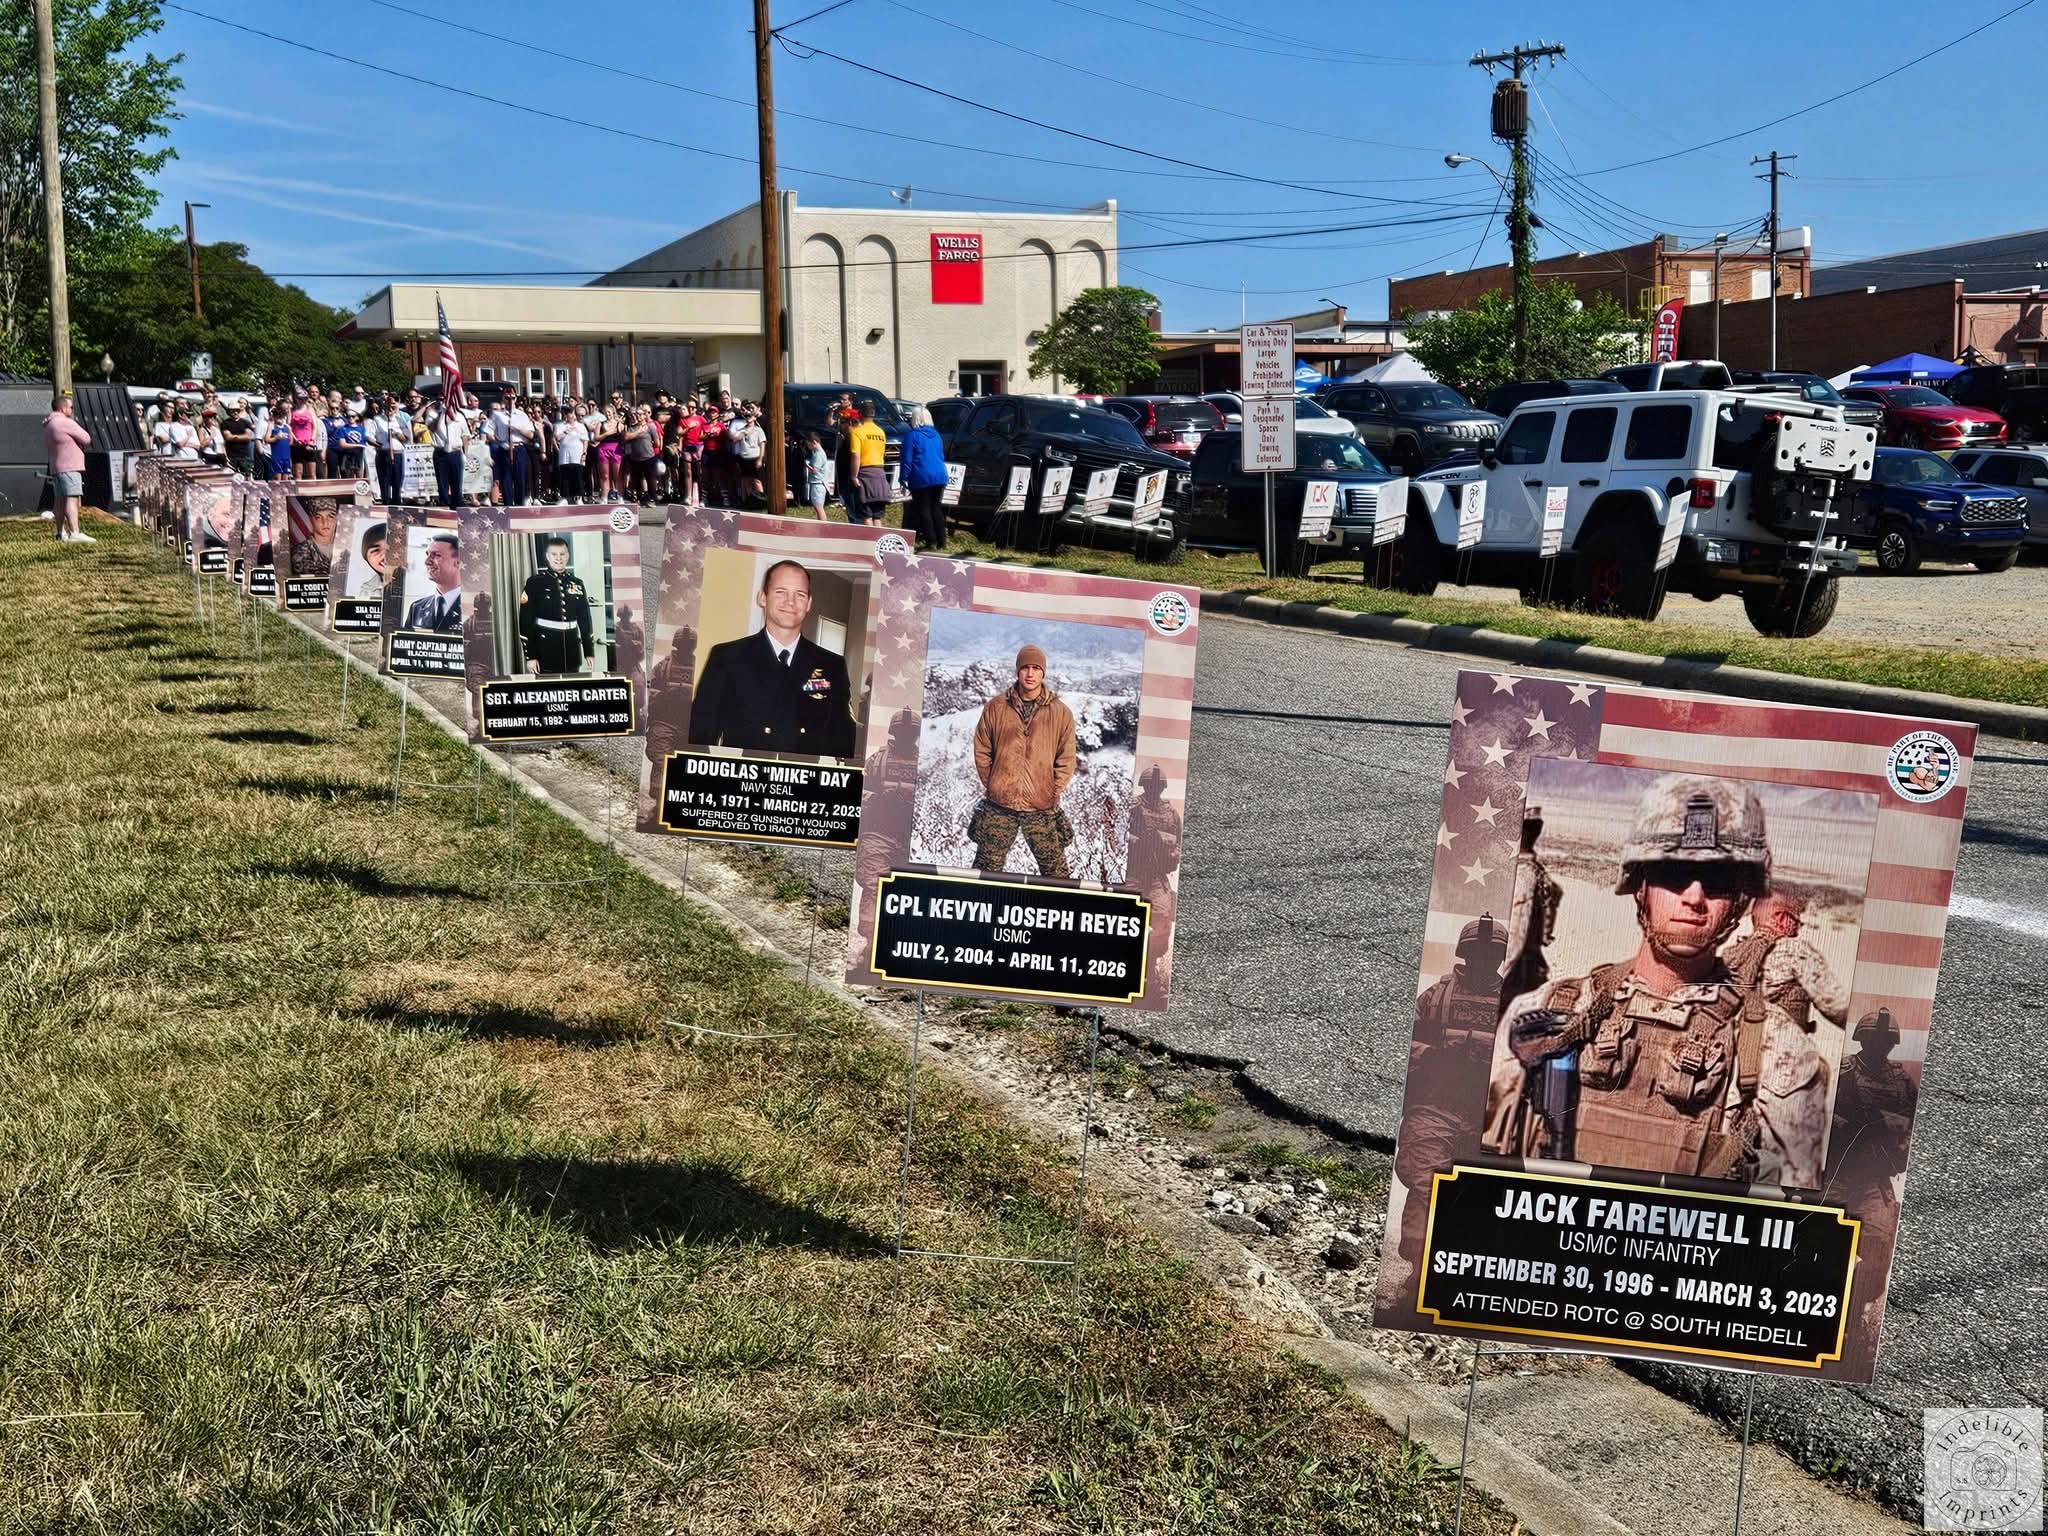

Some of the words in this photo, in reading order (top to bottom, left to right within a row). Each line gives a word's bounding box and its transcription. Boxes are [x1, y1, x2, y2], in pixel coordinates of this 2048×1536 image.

[936, 236, 979, 248] WELLS
[938, 250, 980, 262] FARGO
[1246, 328, 1257, 336] Car
[1260, 328, 1265, 336] &
[1268, 328, 1288, 337] Pickup
[1248, 338, 1270, 348] Parking
[1273, 338, 1287, 346] Only
[1258, 349, 1277, 358] Larger
[1256, 360, 1280, 369] Vehicles
[1252, 371, 1283, 380] Prohibited
[1244, 380, 1264, 390] Towing
[1266, 380, 1292, 389] Enforced
[1257, 406, 1271, 414] Park
[1273, 406, 1280, 414] In
[1252, 414, 1284, 424] Designated
[1258, 424, 1279, 433] Spaces
[1262, 434, 1276, 443] Only
[1259, 444, 1280, 454] Towing
[1256, 454, 1282, 463] Enforced
[394, 640, 415, 649] ARMY
[416, 640, 448, 652] CAPTAIN
[486, 692, 512, 706] SGT.
[514, 690, 580, 704] ALEXANDER
[582, 688, 628, 702] CARTER
[547, 703, 569, 712] USMC
[487, 716, 528, 728] FEBRUARY
[570, 714, 598, 724] MARCH
[1892, 736, 1910, 754] PART
[1912, 732, 1924, 740] OF
[1926, 733, 1944, 742] THE
[1944, 741, 1959, 774] CHANGE
[686, 758, 758, 780] DOUGLAS
[763, 766, 816, 784] "MIKE"
[820, 770, 850, 788] DAY
[740, 782, 768, 794] NAVY
[769, 784, 794, 796] SEAL
[668, 790, 694, 803] MAY
[698, 792, 717, 808] 14,
[720, 794, 750, 808] 1971
[763, 798, 807, 814] MARCH
[810, 802, 830, 817] 27,
[832, 804, 862, 818] 2023
[682, 808, 734, 820] SUFFERED
[736, 813, 748, 822] 27
[750, 814, 800, 826] GUNSHOT
[802, 818, 846, 830] WOUNDS
[698, 818, 750, 831] DEPLOYED
[754, 823, 766, 832] TO
[768, 824, 792, 834] IRAQ
[794, 826, 805, 836] IN
[807, 828, 830, 837] 2007
[885, 893, 923, 918] CPL
[929, 898, 992, 924] KEVYN
[998, 905, 1074, 932] JOSEPH
[1080, 914, 1141, 938] REYES
[993, 928, 1032, 944] USMC
[892, 941, 932, 960] JULY
[935, 945, 950, 964] 2,
[954, 946, 994, 966] 2004
[1010, 951, 1055, 972] APRIL
[1060, 957, 1082, 976] 11,
[1088, 958, 1126, 978] 2026
[1495, 1188, 1577, 1226] JACK
[1586, 1197, 1749, 1246] FAREWELL
[1760, 1218, 1795, 1250] III
[1559, 1230, 1616, 1258] USMC
[1624, 1236, 1721, 1267] INFANTRY
[1433, 1250, 1556, 1286] SEPTEMBER
[1562, 1266, 1595, 1294] 30,
[1603, 1269, 1654, 1297] 1996
[1676, 1277, 1751, 1309] MARCH
[1758, 1286, 1778, 1314] 3,
[1783, 1290, 1837, 1318] 2023
[1452, 1292, 1558, 1319] ATTENDED
[1564, 1304, 1620, 1326] ROTC
[1624, 1311, 1645, 1330] @
[1650, 1312, 1720, 1338] SOUTH
[1726, 1322, 1808, 1348] IREDELL
